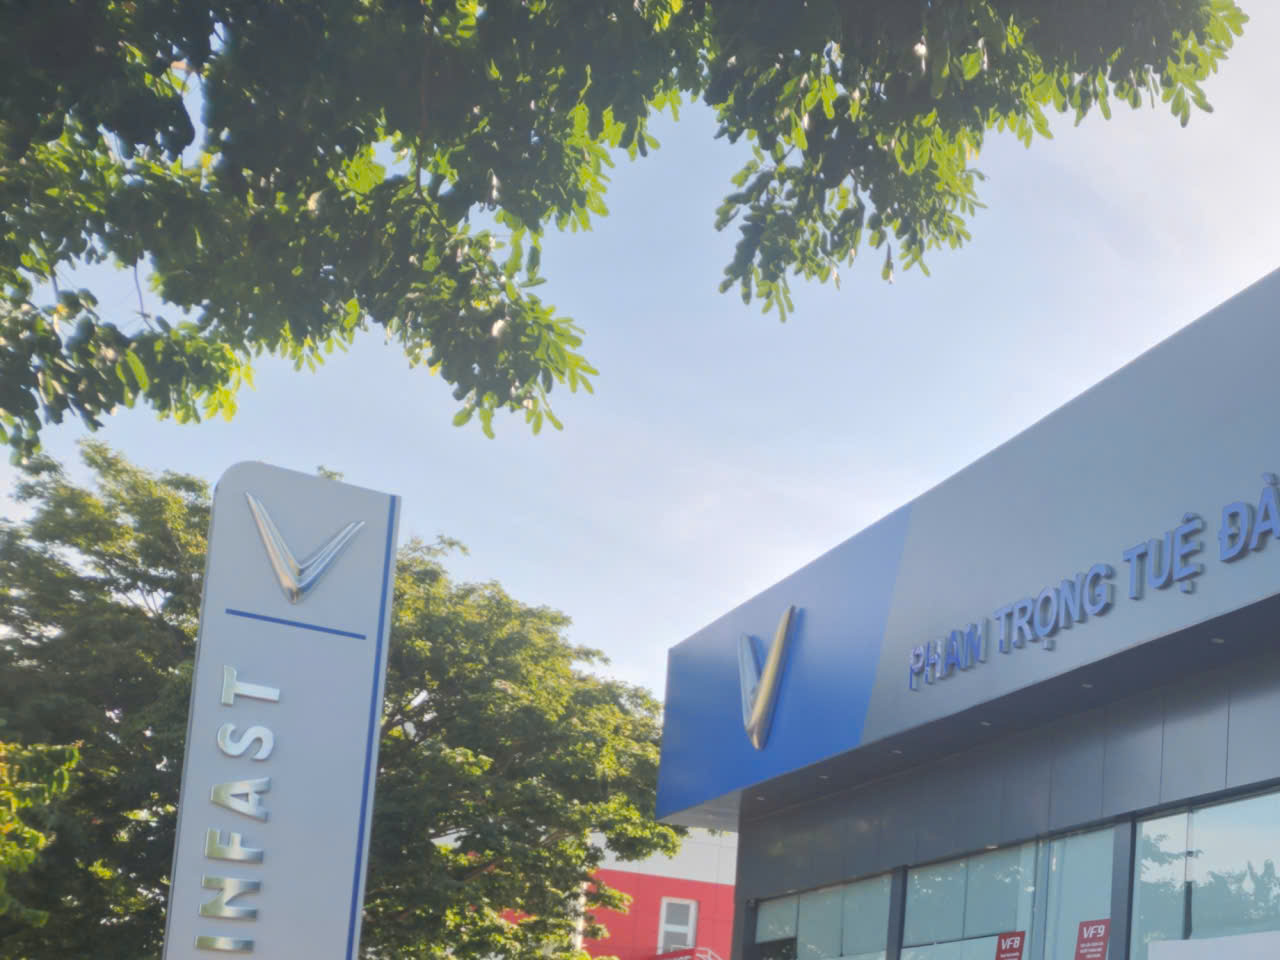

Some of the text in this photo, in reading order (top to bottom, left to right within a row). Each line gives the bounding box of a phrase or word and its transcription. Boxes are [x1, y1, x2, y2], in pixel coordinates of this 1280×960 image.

[909, 616, 989, 690] PHAN
[993, 563, 1115, 654] TRỌNG
[1122, 511, 1204, 600] TUỆ
[1083, 925, 1105, 939] VF9
